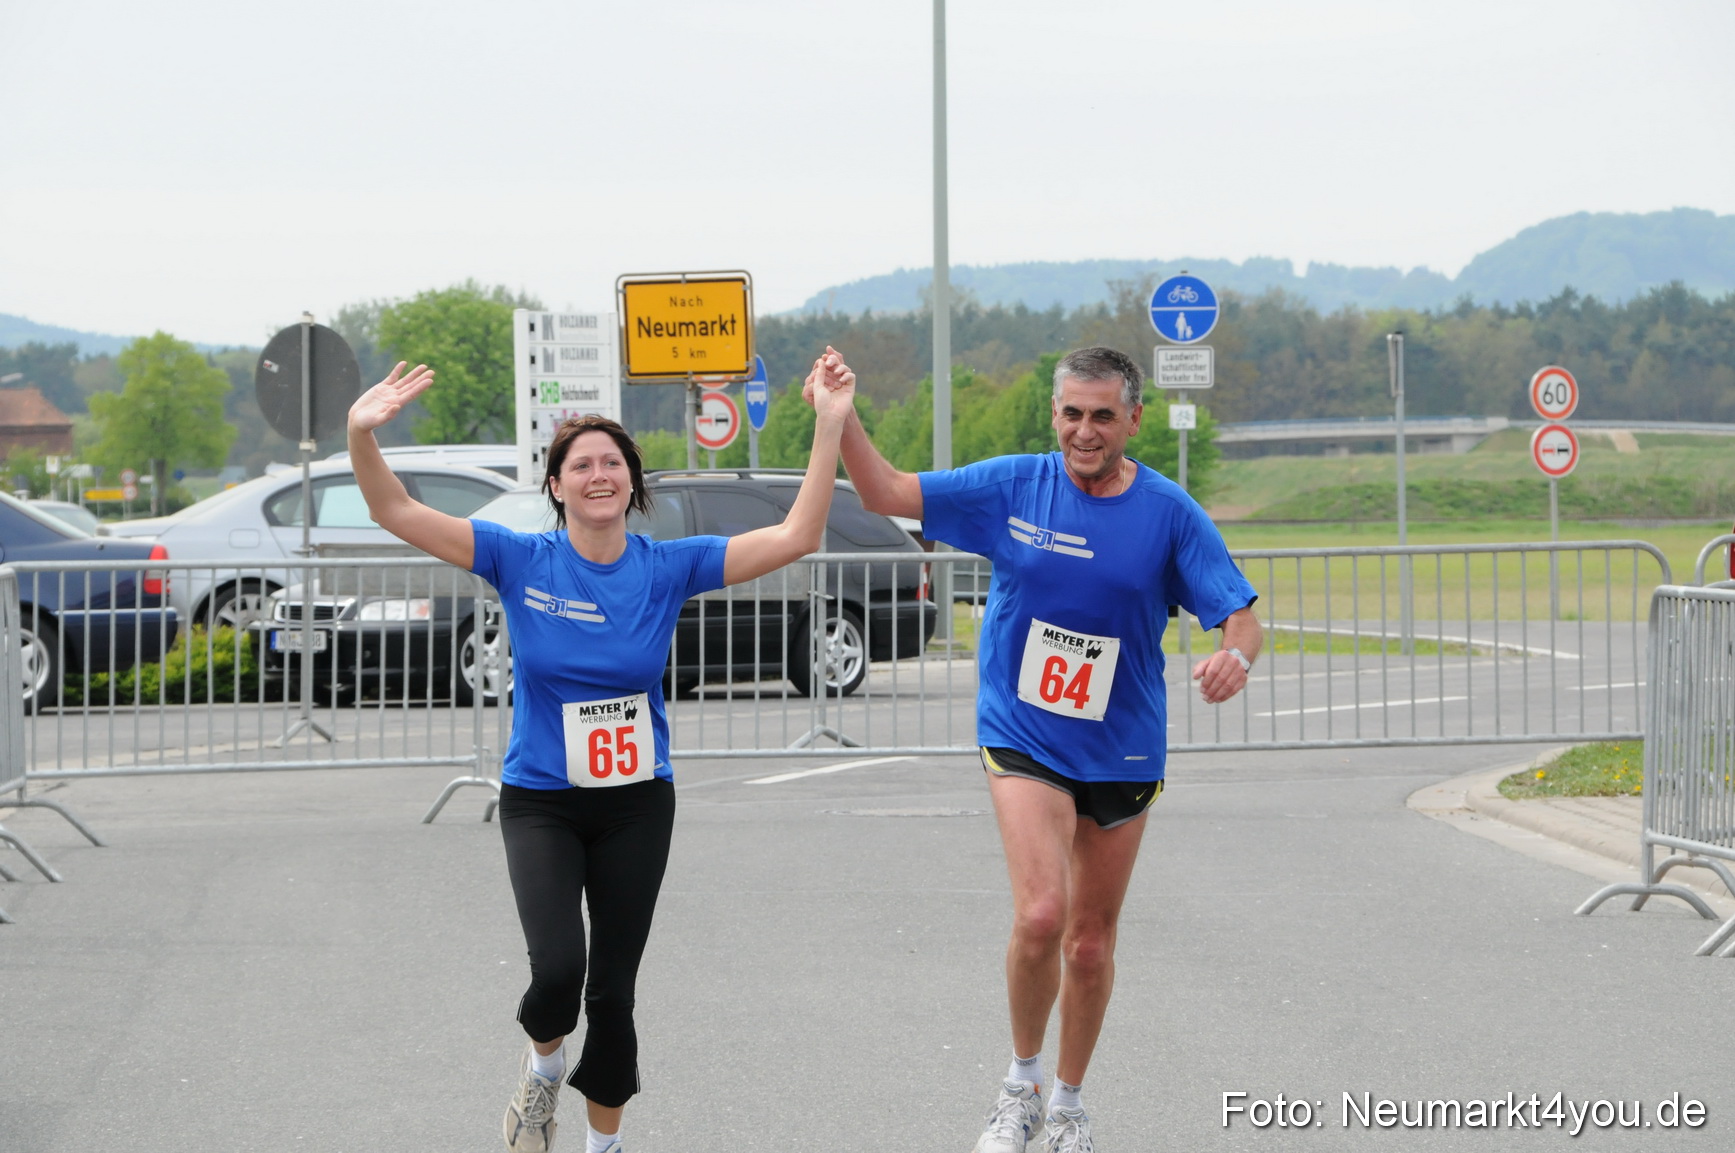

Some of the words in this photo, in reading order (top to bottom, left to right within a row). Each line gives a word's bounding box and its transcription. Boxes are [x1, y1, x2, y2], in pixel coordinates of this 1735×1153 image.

[669, 296, 703, 307] Nach
[637, 313, 737, 338] Neumarkt
[672, 347, 679, 358] 5
[690, 348, 707, 358] km
[1165, 352, 1203, 361] Landwirt-
[1161, 363, 1207, 372] schaftlicher
[1161, 373, 1191, 381] Verkehr
[1194, 373, 1208, 381] frei
[540, 381, 560, 404] SHB
[1543, 383, 1567, 405] 60
[1042, 628, 1085, 648] MEYER
[1041, 637, 1083, 656] WERBUNG
[1039, 655, 1093, 709] 64
[579, 703, 621, 716] MEYER
[580, 713, 623, 724] WERBUNG
[588, 725, 638, 779] 65
